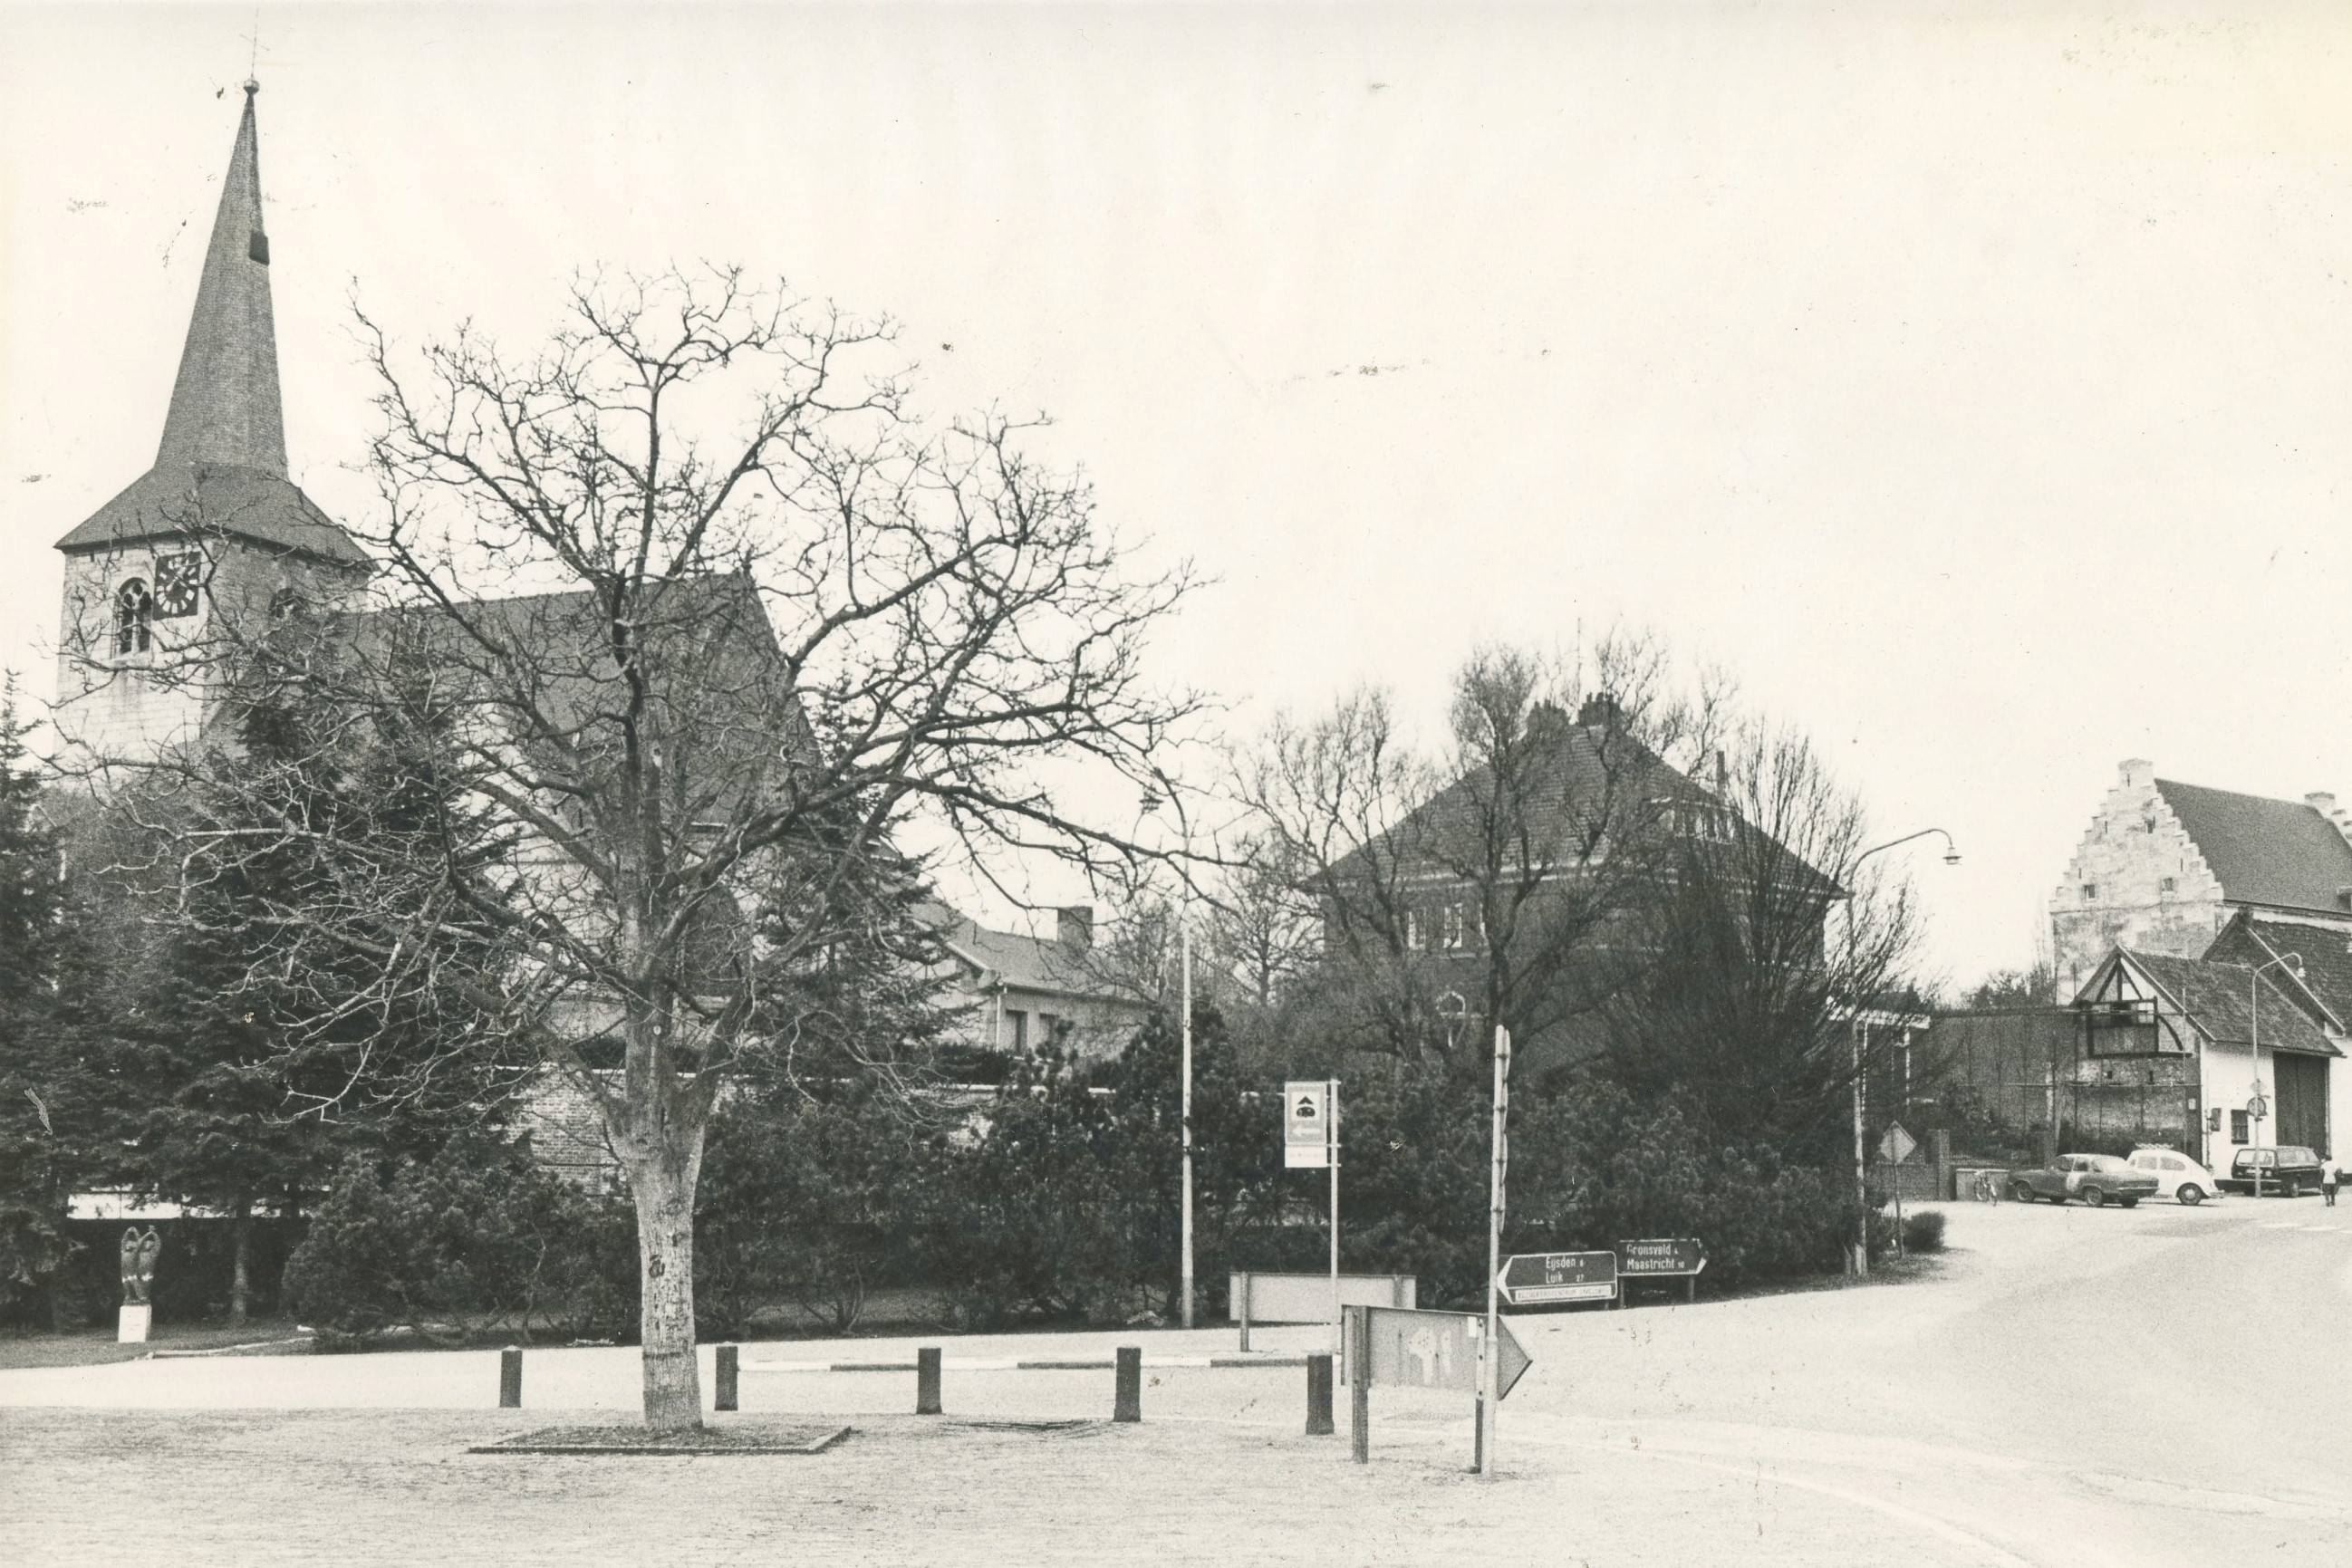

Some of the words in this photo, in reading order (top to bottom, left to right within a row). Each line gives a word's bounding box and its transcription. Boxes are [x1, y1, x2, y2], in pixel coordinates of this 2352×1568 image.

[1626, 1243, 1671, 1255] Gronsveld
[1627, 1257, 1674, 1270] Maastricht
[1546, 1271, 1563, 1284] Luik
